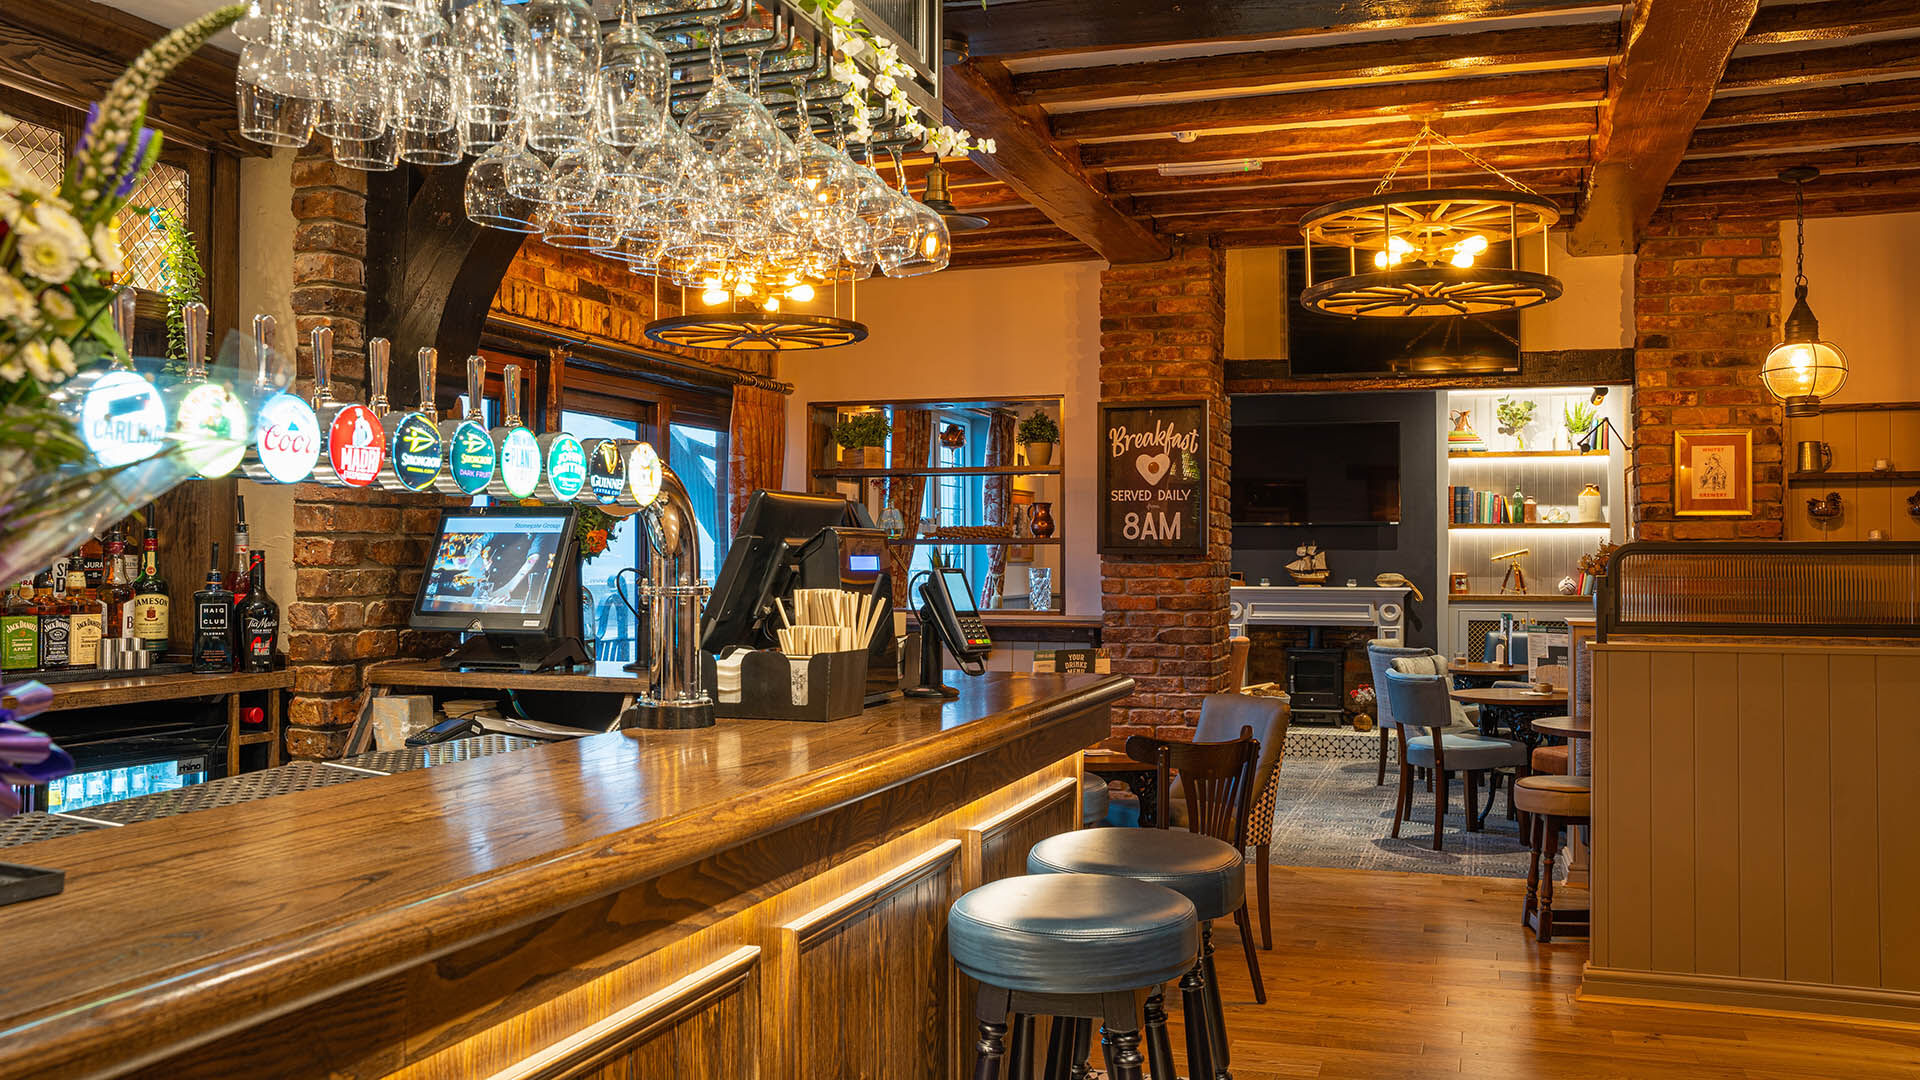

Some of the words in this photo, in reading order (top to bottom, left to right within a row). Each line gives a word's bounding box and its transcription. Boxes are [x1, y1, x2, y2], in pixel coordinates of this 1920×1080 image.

[1109, 419, 1199, 457] Breakfast
[1111, 490, 1152, 501] SERVED
[1158, 489, 1191, 501] DAILY
[1123, 512, 1181, 540] 8AM
[136, 598, 168, 607] AMESON
[1068, 653, 1085, 661] YOUR
[1065, 661, 1088, 669] DRINKS
[180, 760, 201, 771] rhino
